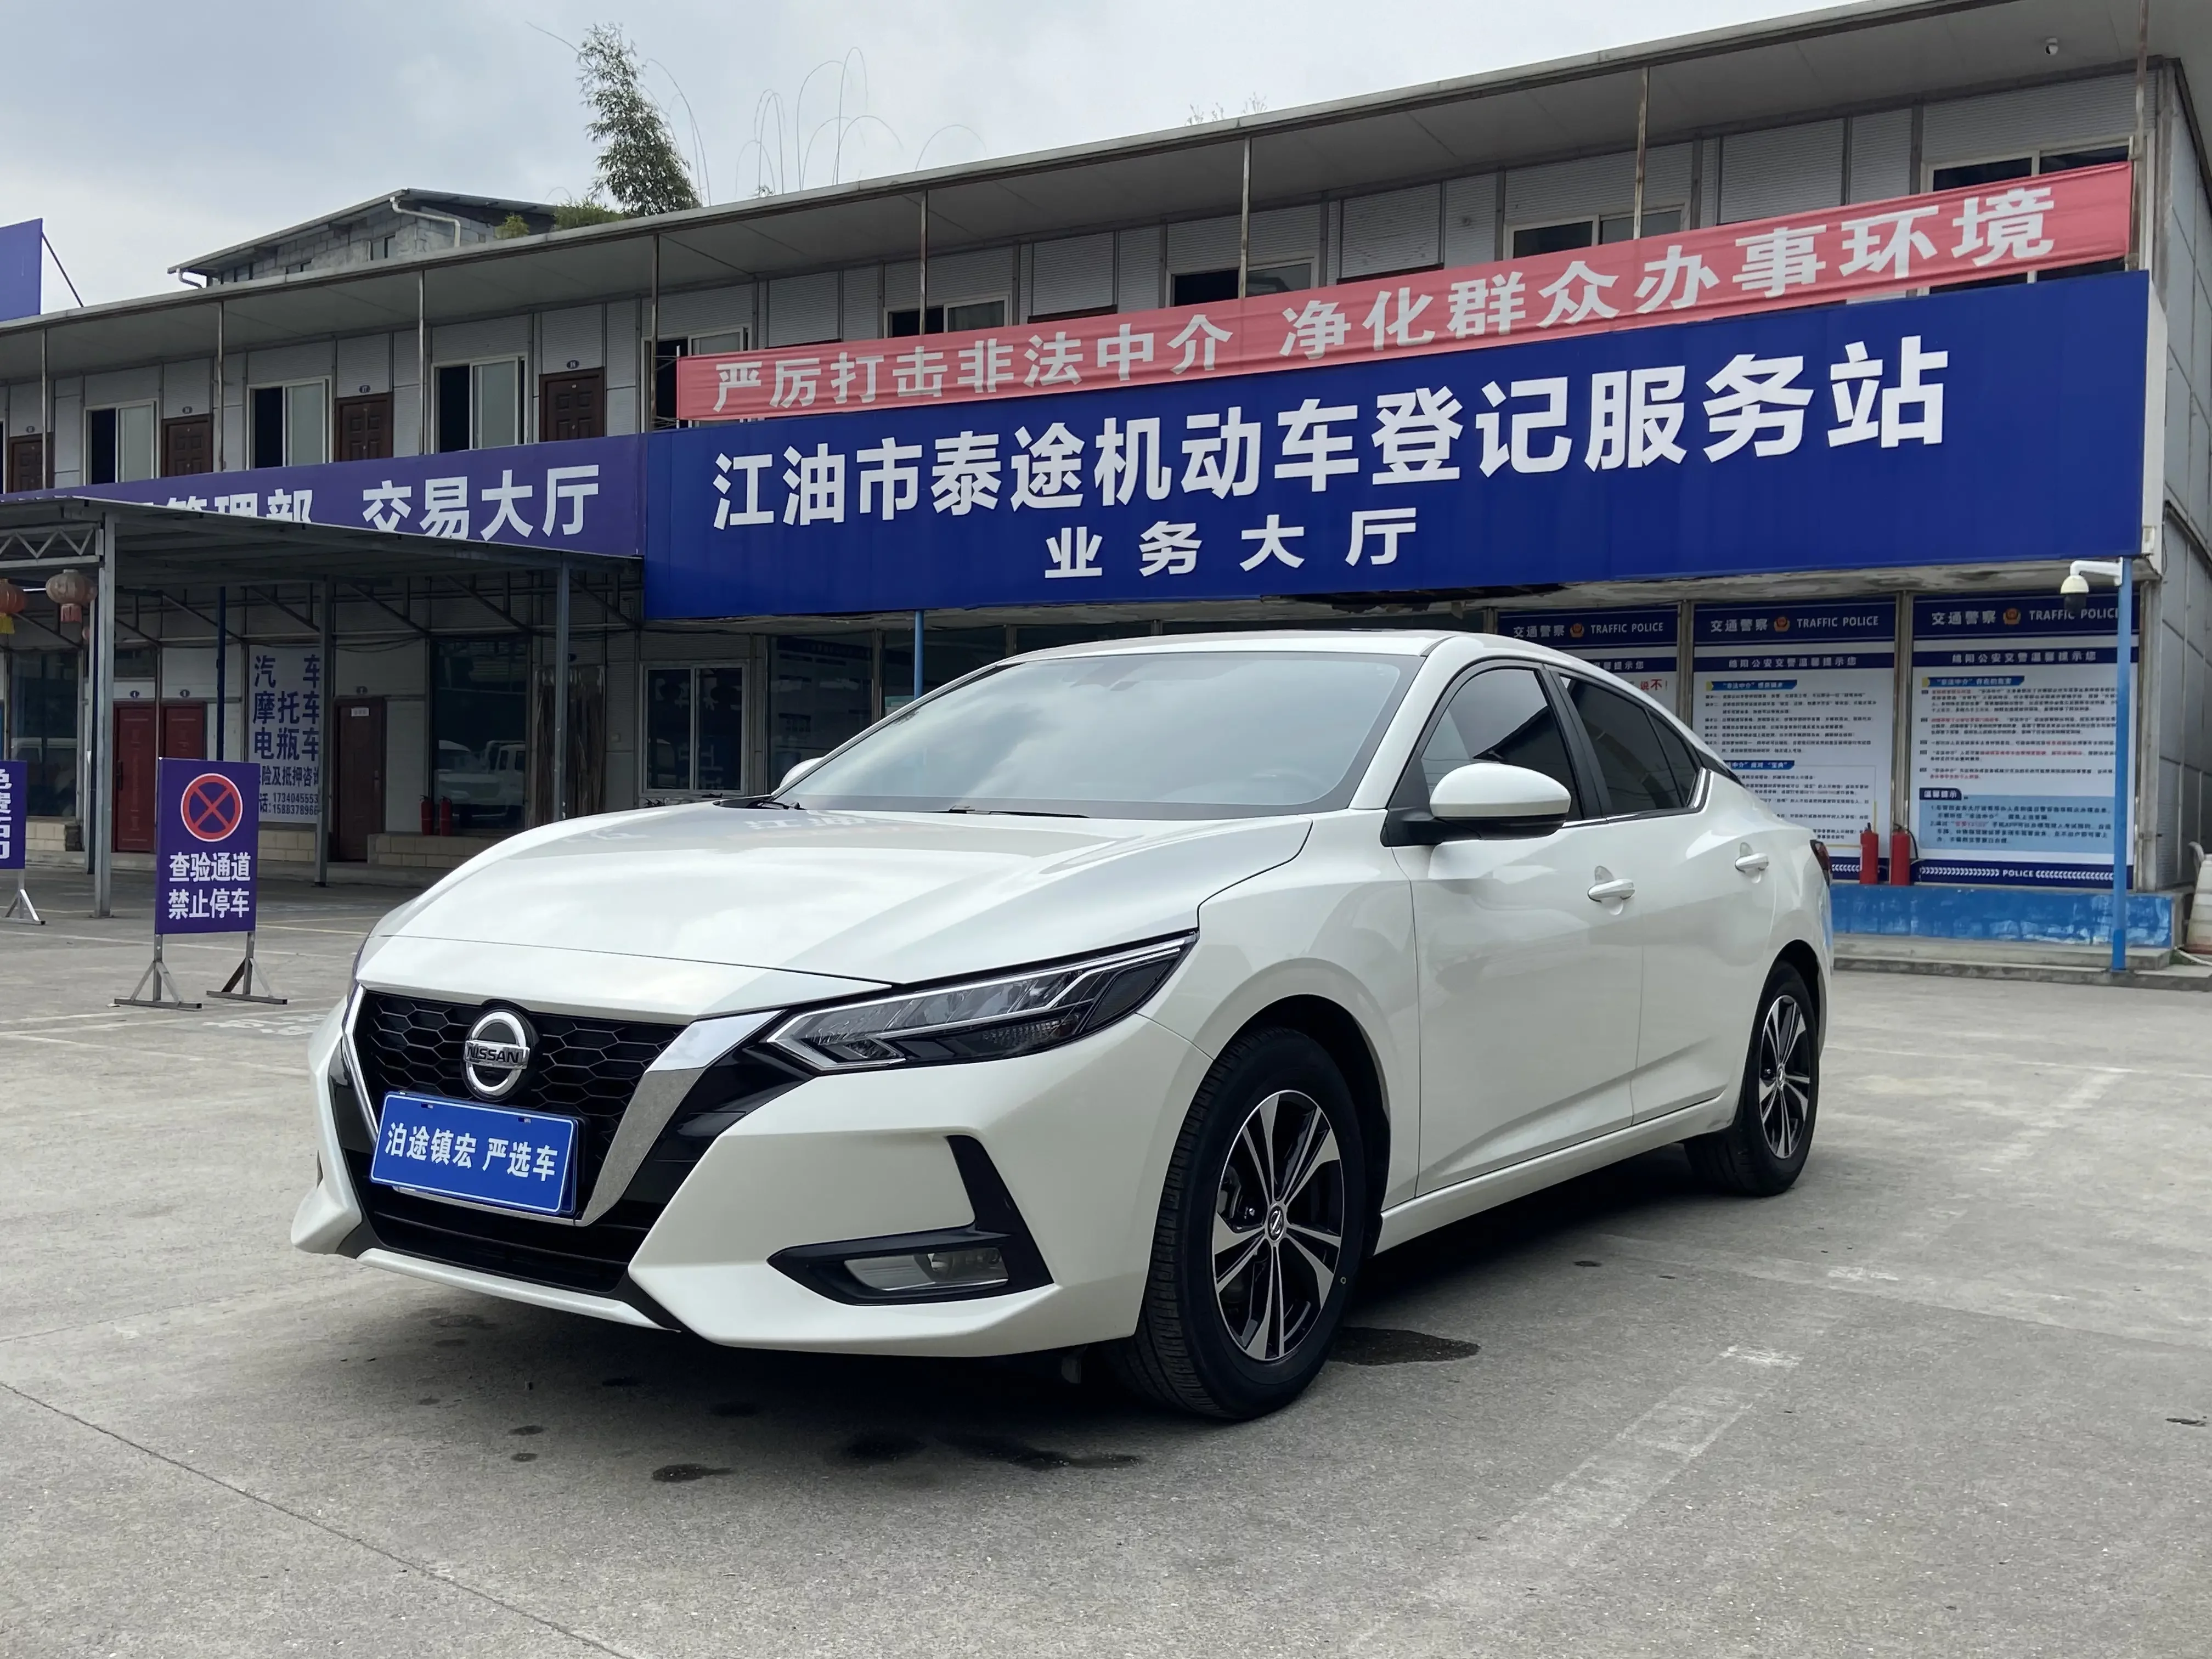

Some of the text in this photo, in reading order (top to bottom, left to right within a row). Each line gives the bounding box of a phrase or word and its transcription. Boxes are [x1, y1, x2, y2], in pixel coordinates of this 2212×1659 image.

[713, 187, 2055, 413] 严厉打击非法中介 净化群众办事环境
[712, 335, 1949, 531] 江油市泰途机动车登记服务站
[363, 465, 599, 542] 交易大厅
[1045, 506, 1417, 579] 业务大厅
[1591, 624, 1627, 634] TRAFFIC
[1632, 622, 1663, 632] POLICE
[1711, 616, 1878, 633] 交通警察 TRAFFIC POLICE
[1931, 610, 1996, 625] 交通警察
[253, 690, 320, 725] 摩托车
[254, 726, 319, 761] 电瓶车
[259, 765, 319, 787] 险及抵押咨
[169, 851, 251, 882] 查验通道
[2002, 869, 2033, 878] POLICE
[168, 888, 250, 920] 禁止停车
[467, 1043, 519, 1063] NISSAN
[385, 1122, 557, 1181] 泊途镇宏 严选车
